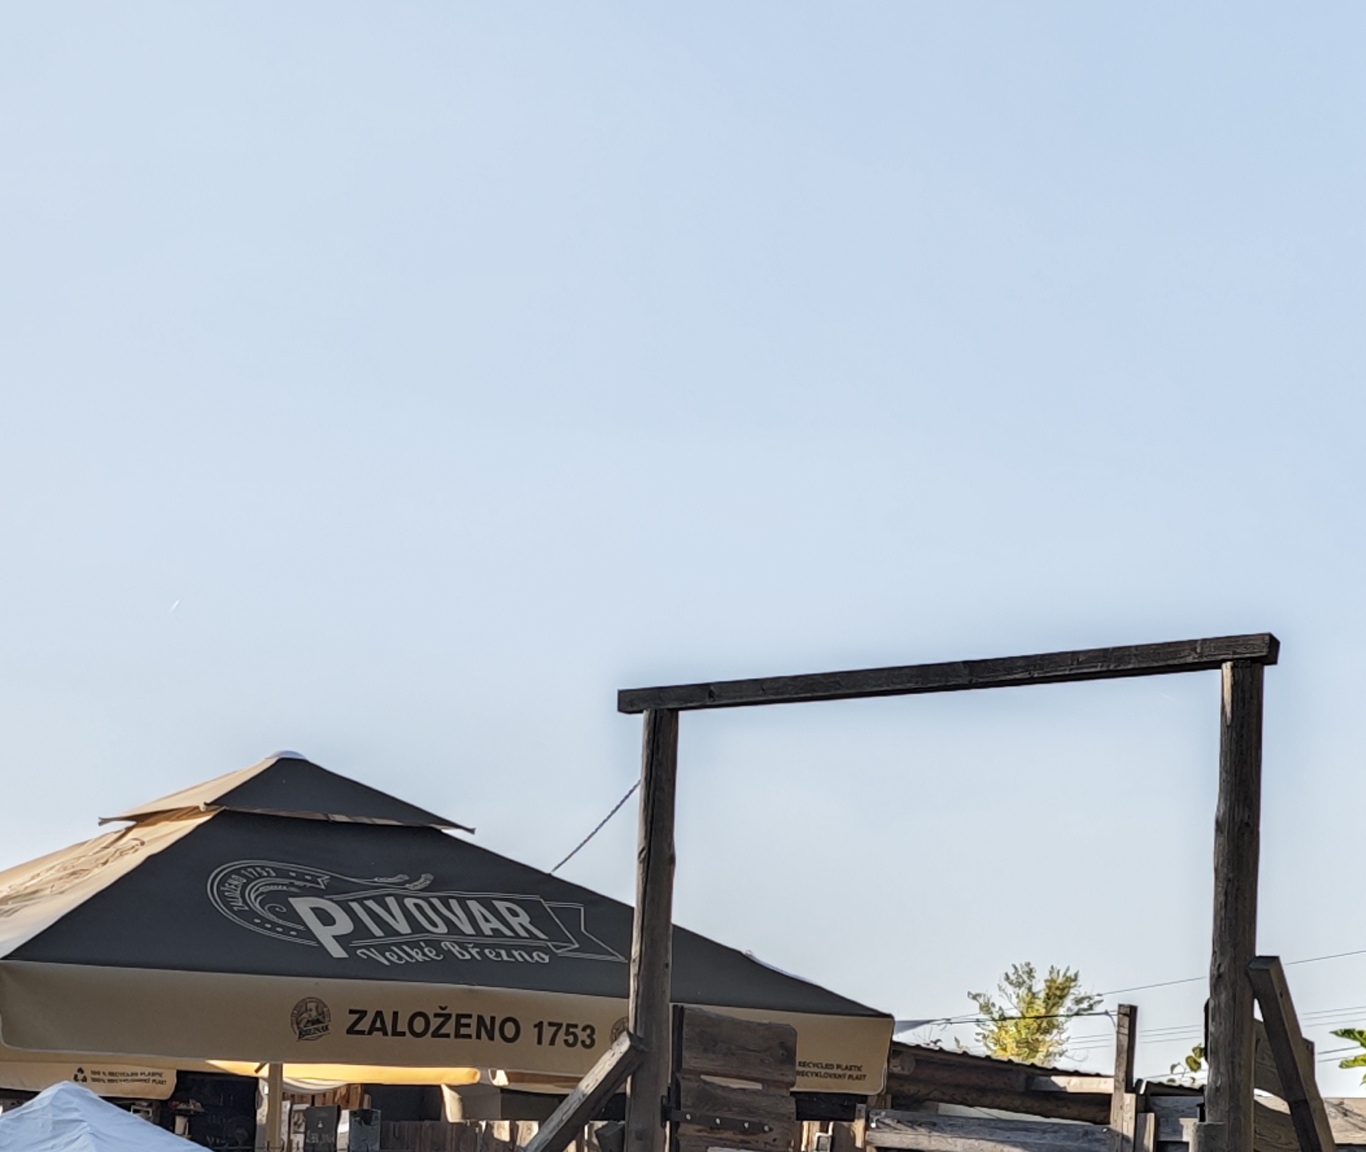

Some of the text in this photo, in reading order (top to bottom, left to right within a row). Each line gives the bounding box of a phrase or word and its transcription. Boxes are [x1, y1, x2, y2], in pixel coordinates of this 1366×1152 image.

[287, 896, 549, 958] PIVOVAR
[356, 941, 550, 966] Velké Březno
[346, 1006, 596, 1049] ZALOŽENO 1753
